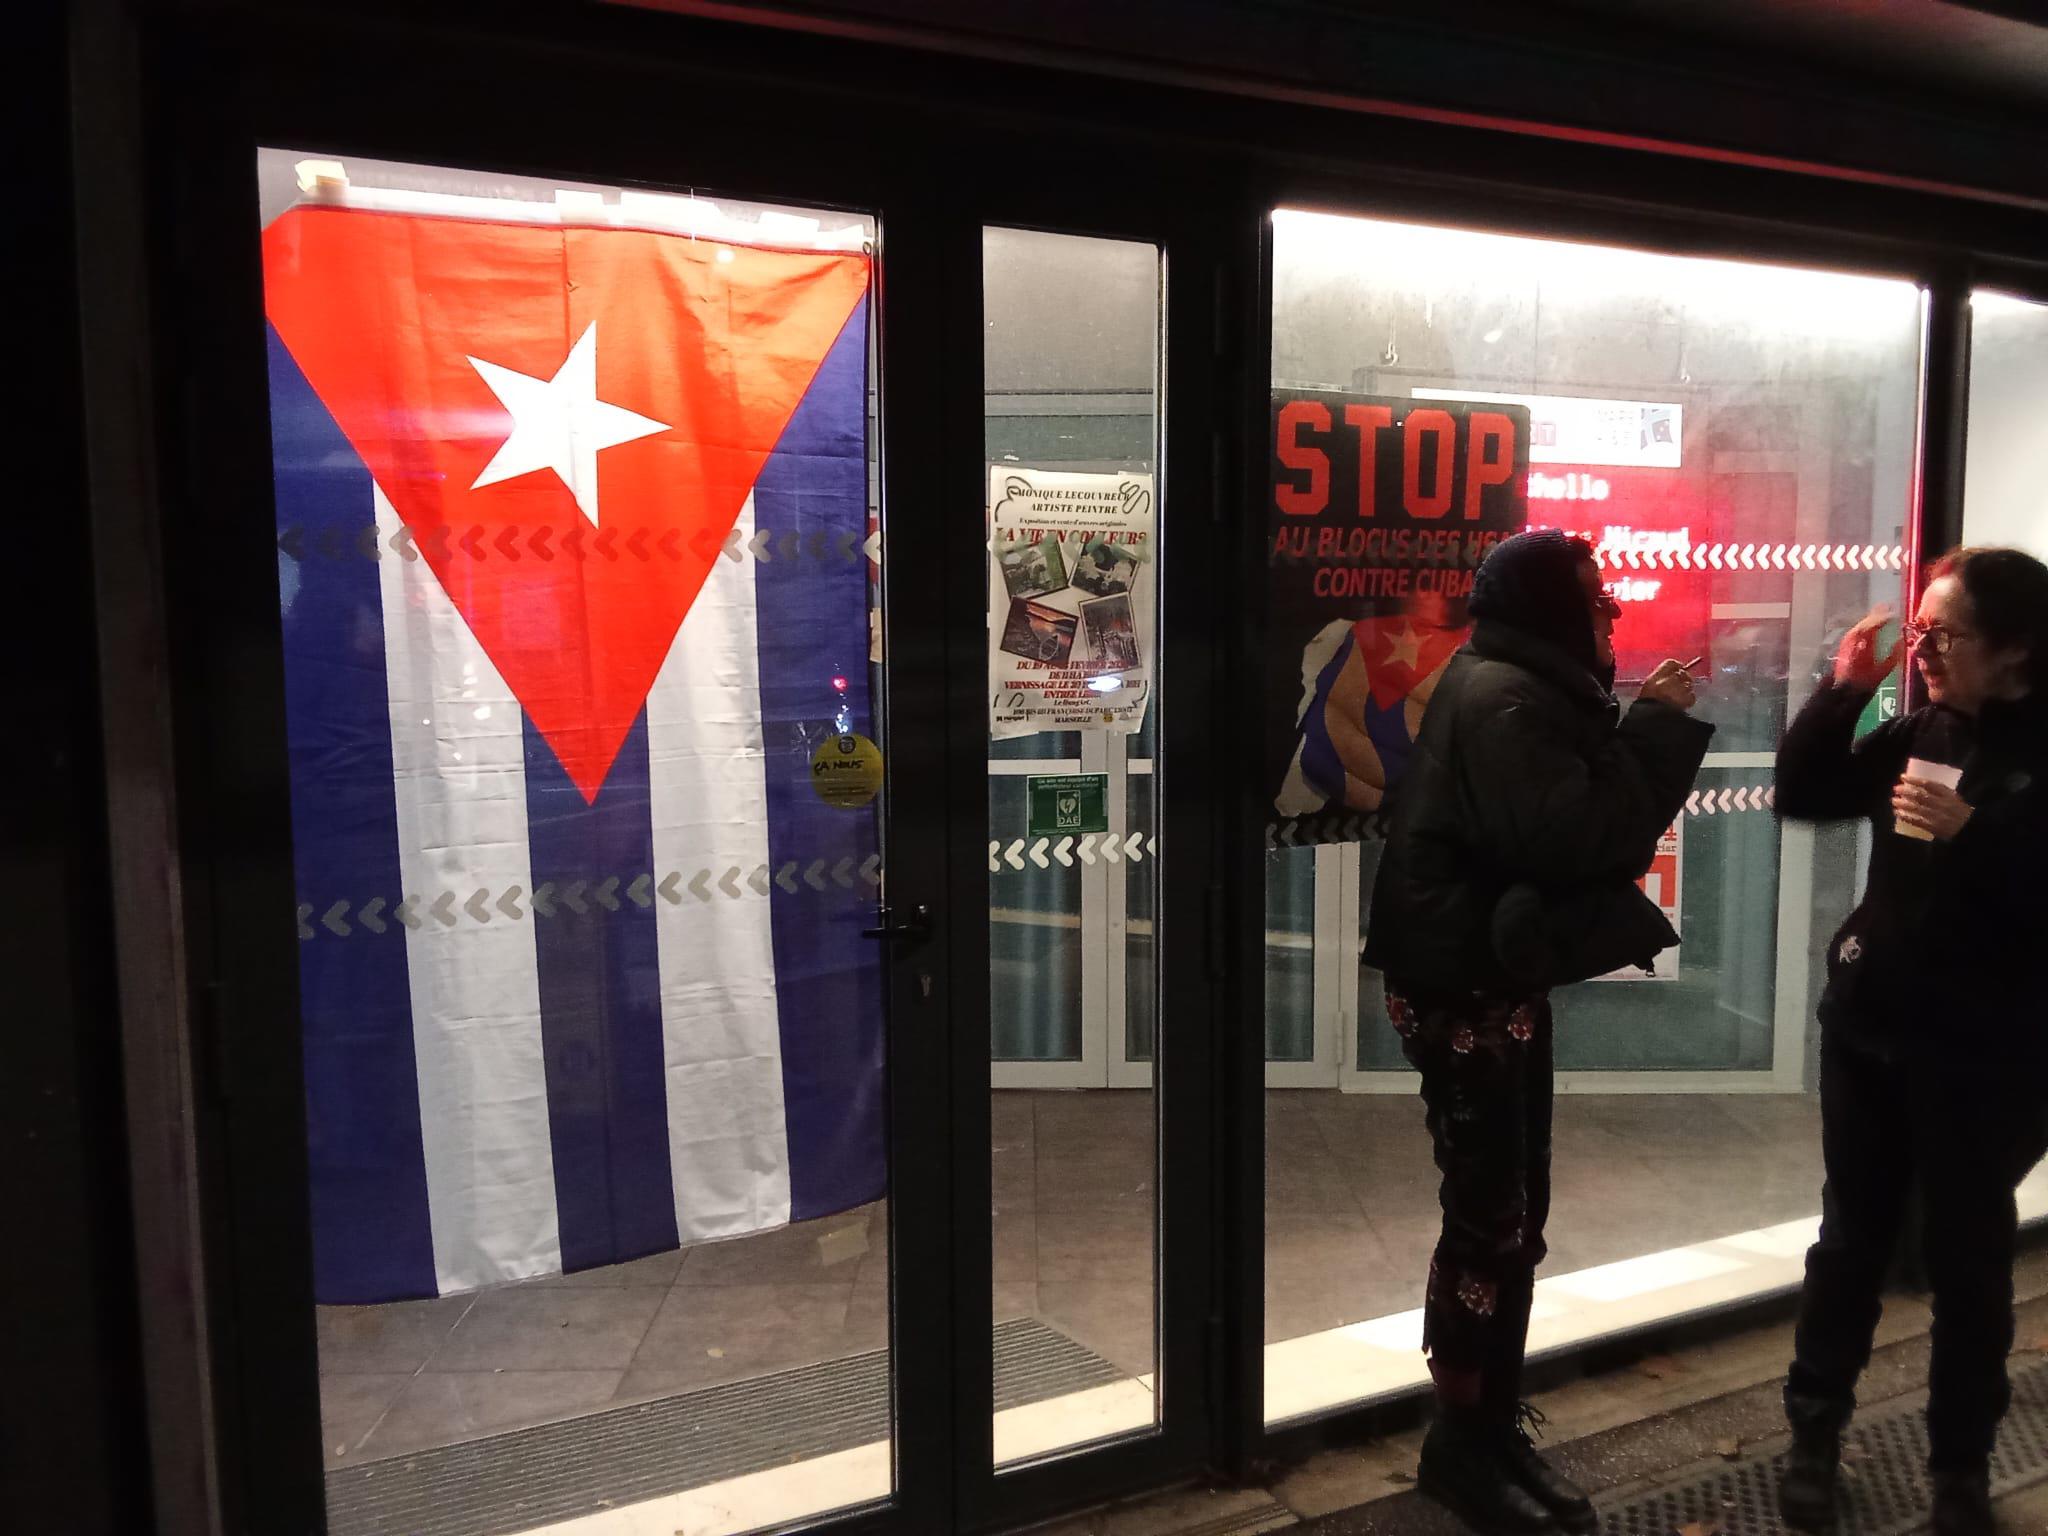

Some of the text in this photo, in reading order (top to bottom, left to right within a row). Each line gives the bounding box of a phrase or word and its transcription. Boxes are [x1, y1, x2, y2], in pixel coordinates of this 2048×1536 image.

[1275, 400, 1516, 520] STOP
[1018, 489, 1130, 502] MONIQUE LECOUVREUR
[1031, 503, 1118, 514] ARTISTE PEINTRE
[1274, 526, 1311, 557] AU
[1316, 527, 1411, 560] BLOCUS
[1416, 529, 1460, 559] DES
[1313, 567, 1474, 599] CONTRE CUBA
[1059, 816, 1079, 825] DAE
